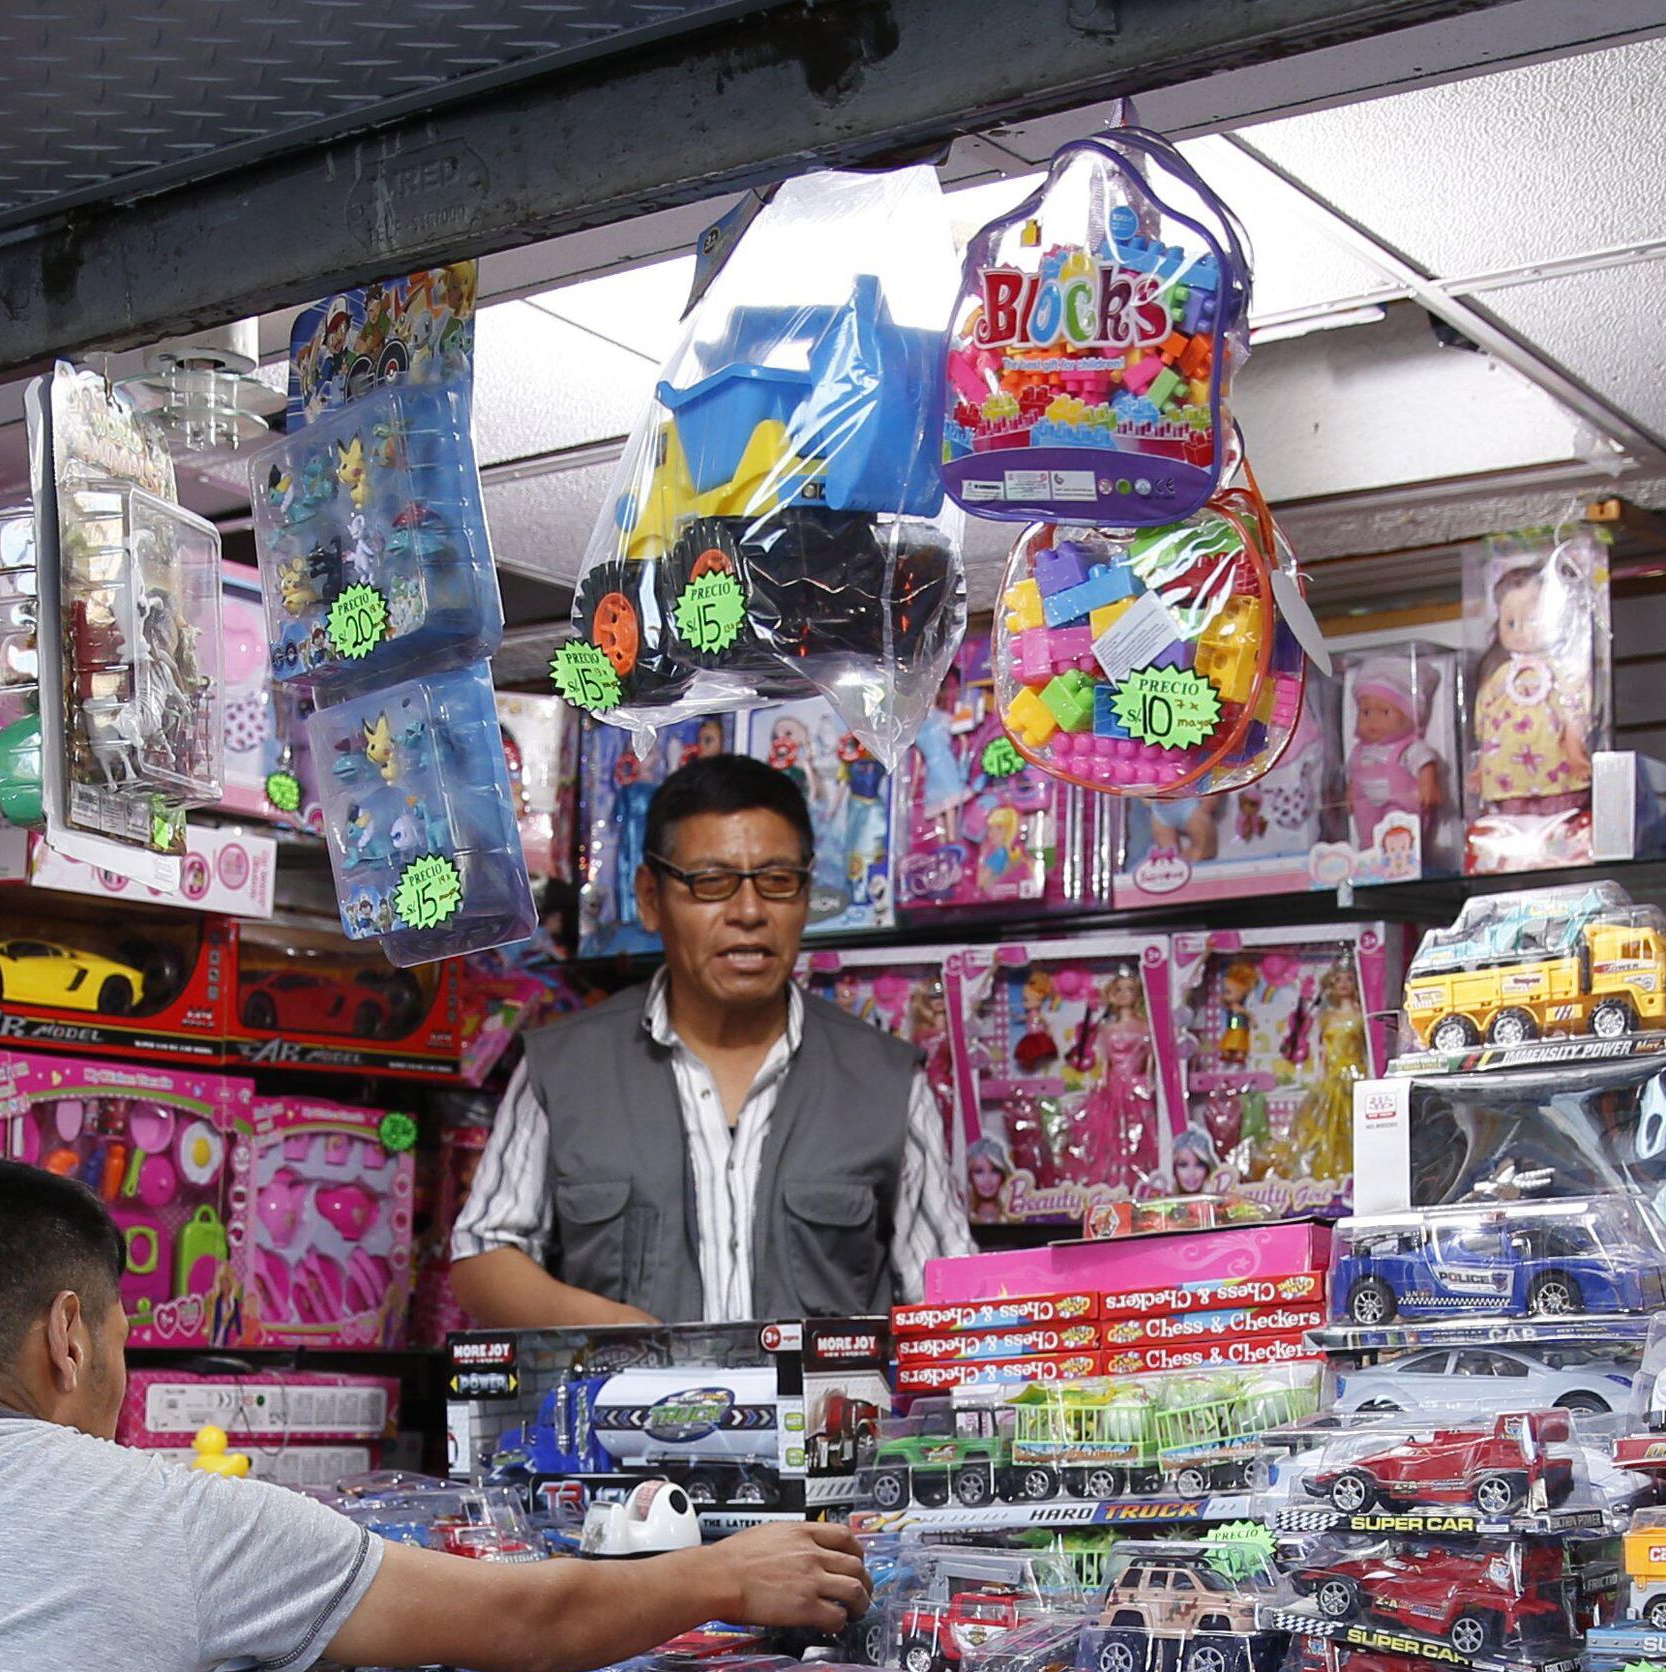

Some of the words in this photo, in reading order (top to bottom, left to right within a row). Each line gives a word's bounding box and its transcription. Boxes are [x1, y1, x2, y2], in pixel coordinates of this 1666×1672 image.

[691, 582, 731, 600] PRECIO
[337, 593, 369, 615] PRECIO
[566, 654, 600, 664] PRECIO
[1139, 679, 1199, 695] PRECIO
[1142, 694, 1172, 737] 10
[409, 864, 442, 886] PRECIO
[1439, 1270, 1492, 1285] POLICE
[1030, 1506, 1093, 1522] HARD
[1104, 1499, 1203, 1520] TRUCK
[703, 1518, 722, 1528] THE
[1350, 1517, 1426, 1531] SUPER
[1427, 1517, 1474, 1531] CAR
